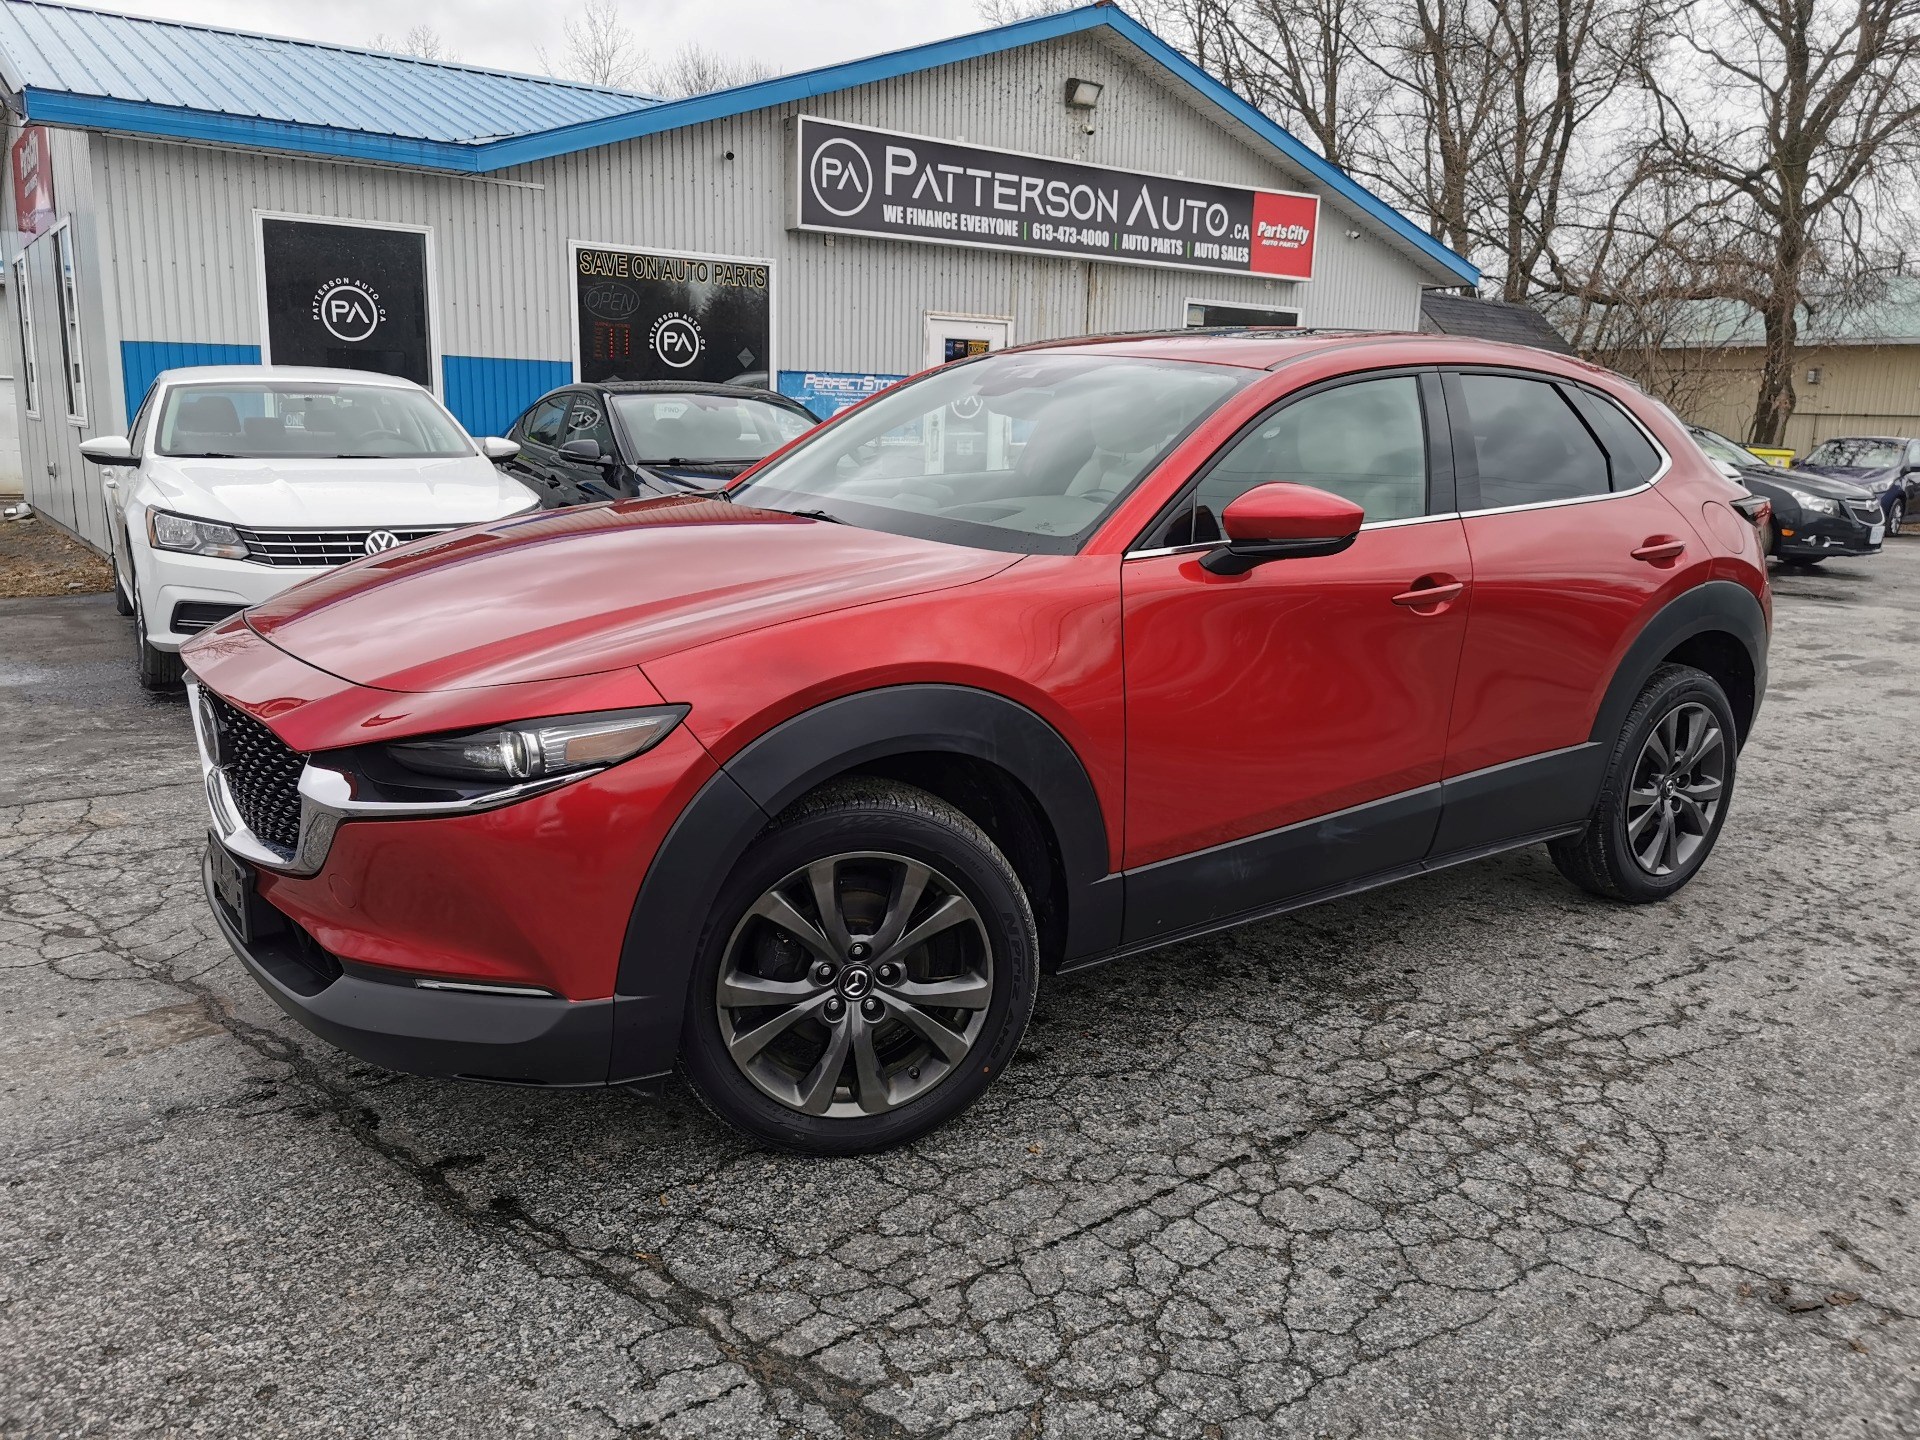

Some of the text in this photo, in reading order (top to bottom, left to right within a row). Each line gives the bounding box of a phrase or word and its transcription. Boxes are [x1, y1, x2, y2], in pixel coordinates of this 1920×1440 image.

[885, 145, 1119, 224] PATTERSON
[883, 204, 1019, 237] WE FINANCE EVERYONE
[1032, 223, 1109, 248] 613-473-4000
[1122, 233, 1183, 256] AUTO PARTS
[1261, 239, 1299, 249] AUTO PARTS
[1194, 242, 1249, 263] AUTO SALES
[579, 251, 766, 289] SAVE ON AUTO PARTS
[312, 277, 349, 321] PATTERSON
[354, 280, 379, 300] AUTO
[587, 290, 635, 312] OPEN
[331, 300, 370, 324] PA
[649, 311, 679, 350] PATTERSON
[682, 313, 701, 332] AUTO
[663, 331, 693, 352] PA
